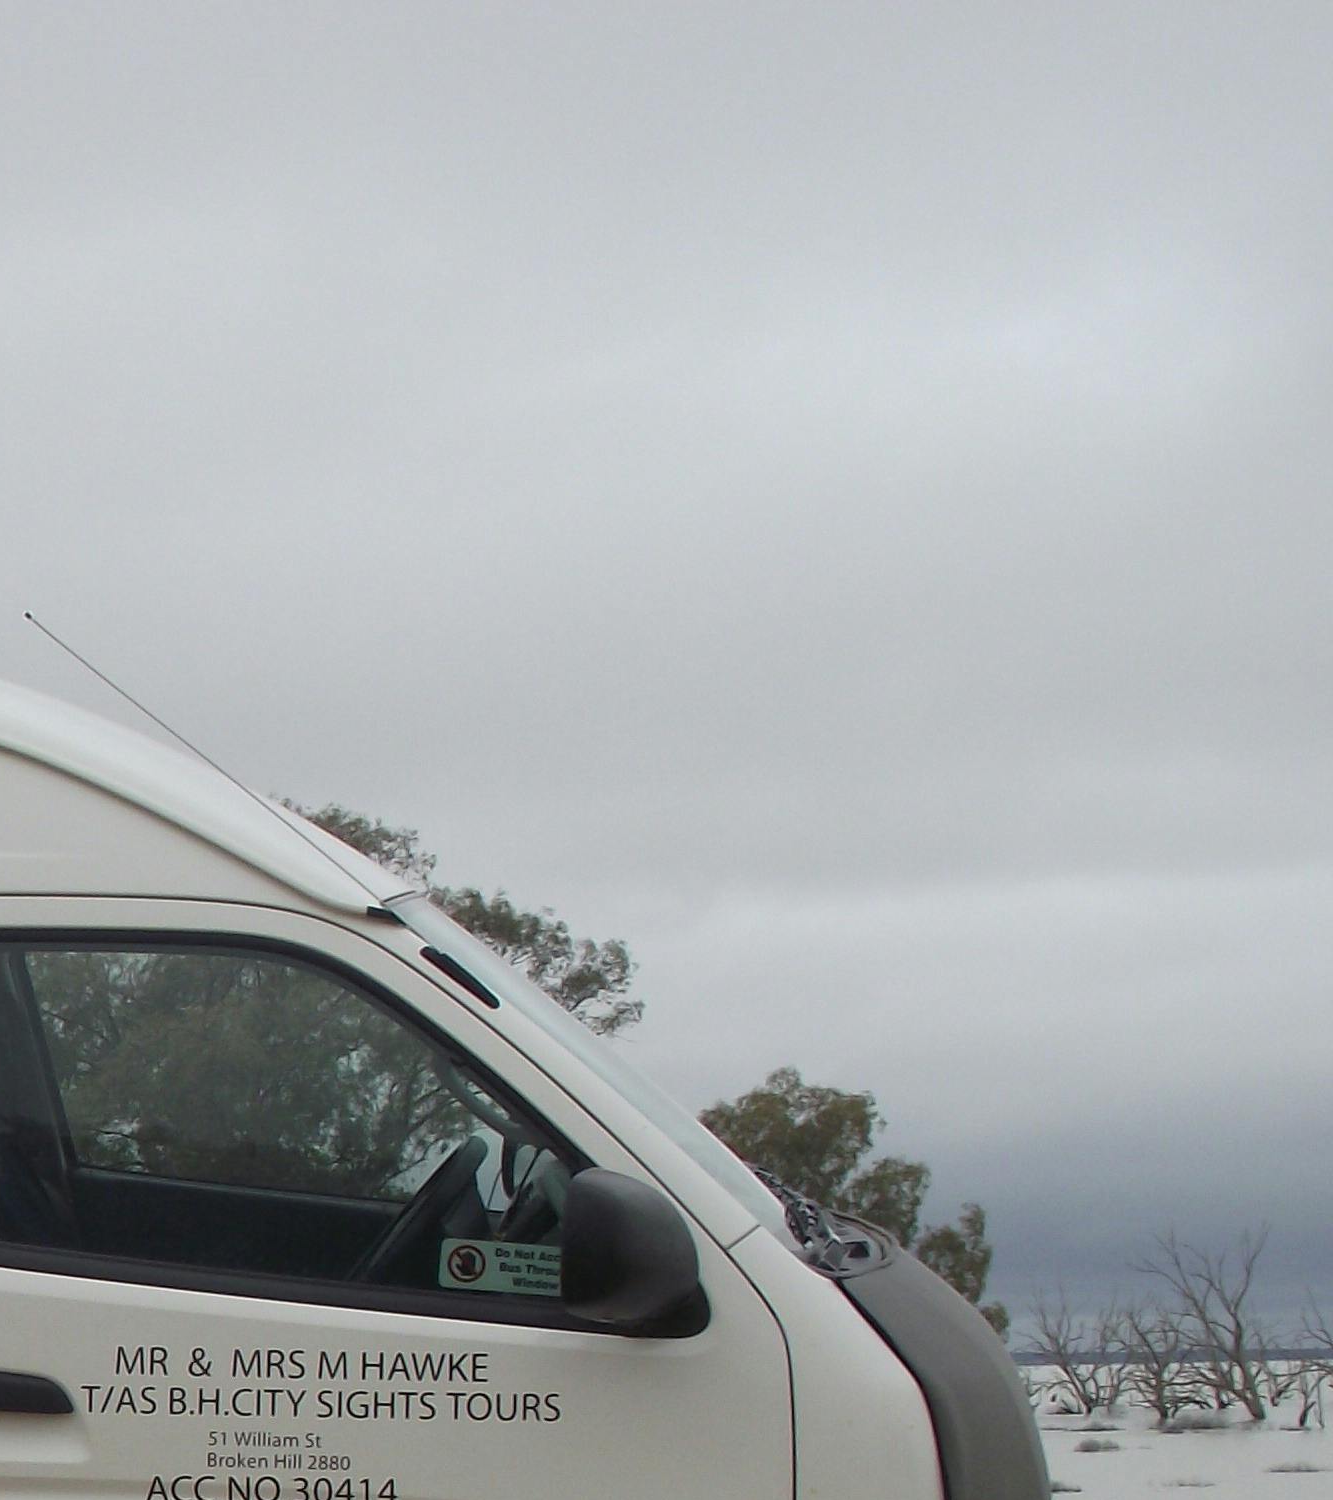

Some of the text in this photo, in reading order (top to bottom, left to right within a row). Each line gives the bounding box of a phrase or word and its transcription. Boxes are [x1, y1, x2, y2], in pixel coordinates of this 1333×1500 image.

[514, 1249, 534, 1260] Not
[115, 1346, 489, 1383] MR & MRS M HAWKE
[80, 1385, 157, 1416] T/AS
[317, 1391, 437, 1421] SIGHTS
[446, 1393, 562, 1422] TOURS
[208, 1431, 322, 1449] 51 William St
[207, 1452, 351, 1471] Broken Hill 2880
